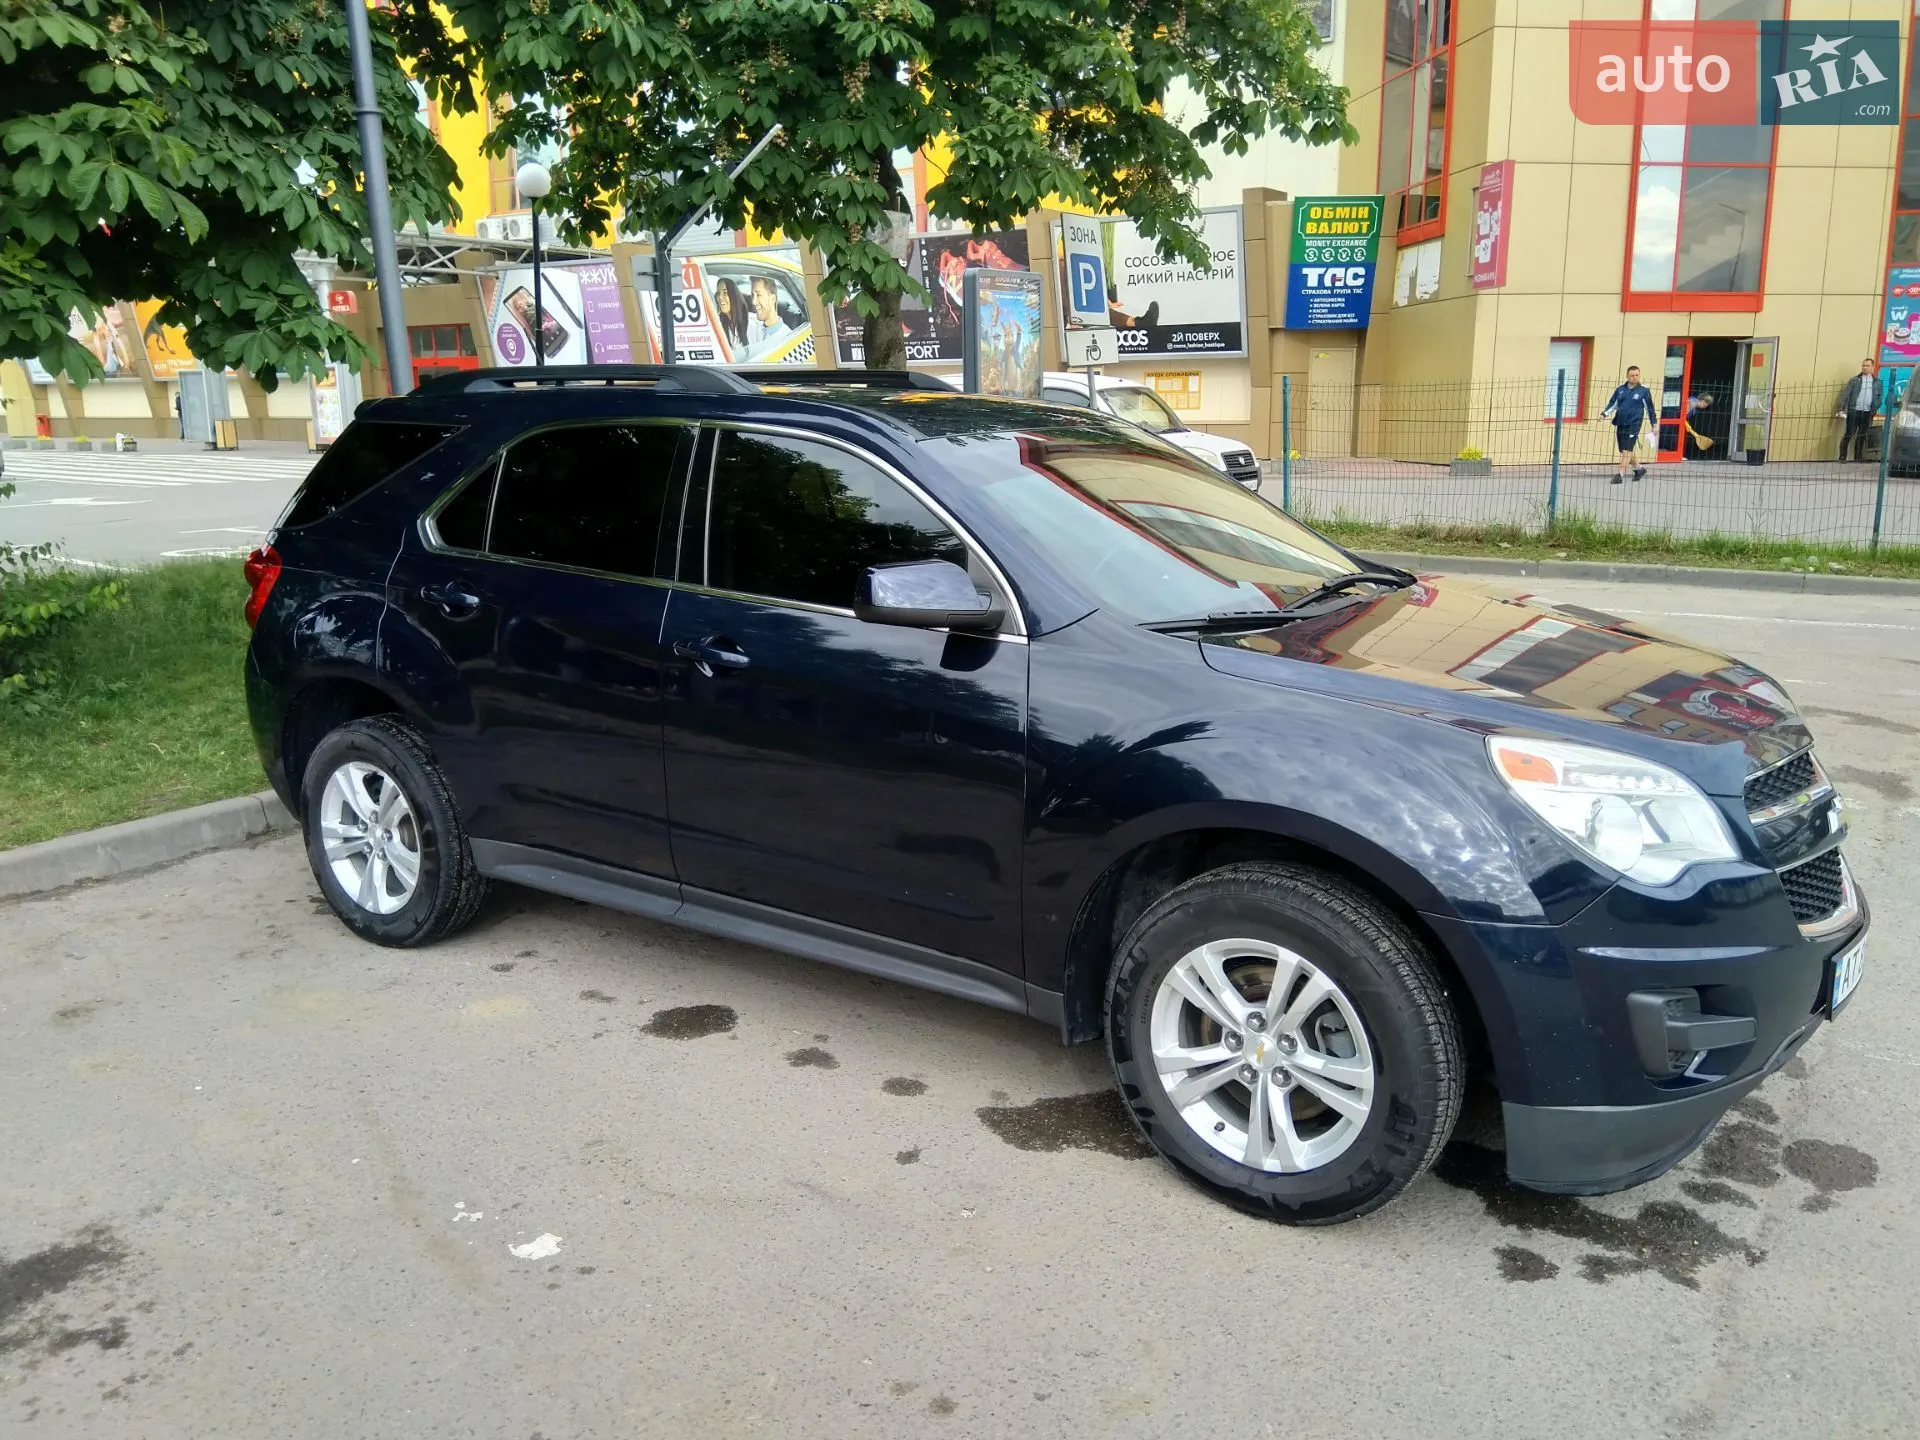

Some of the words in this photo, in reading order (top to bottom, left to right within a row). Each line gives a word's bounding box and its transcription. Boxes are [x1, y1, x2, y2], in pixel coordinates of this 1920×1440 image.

[1309, 206, 1369, 219] ОБМІН
[1305, 221, 1370, 234] ВАЛЮТ
[1069, 226, 1097, 244] ЗОНА
[1305, 239, 1331, 247] MONEY
[1332, 239, 1368, 247] EXCHANGE
[1079, 262, 1096, 306] P
[1127, 269, 1173, 286] ДИКИЙ
[655, 294, 701, 323] 59
[1172, 332, 1184, 342] 2Й
[1185, 332, 1220, 341] ПОВЕРХ
[904, 345, 940, 359] PORT
